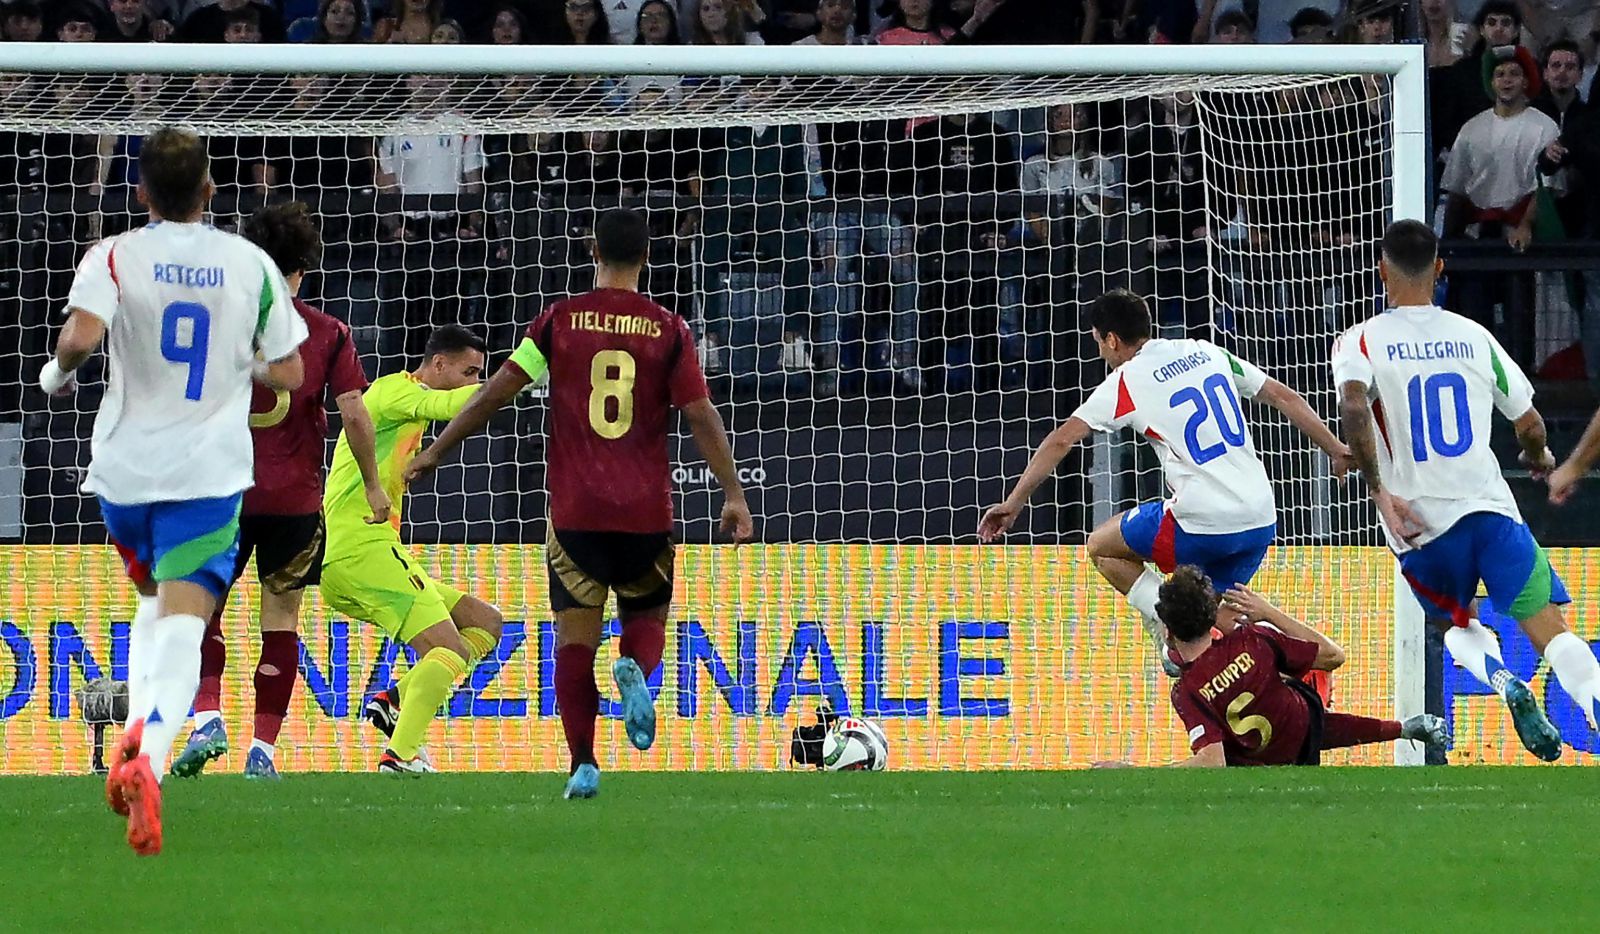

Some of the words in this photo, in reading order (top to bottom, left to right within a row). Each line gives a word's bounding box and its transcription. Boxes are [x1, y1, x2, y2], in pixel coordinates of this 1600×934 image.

[153, 263, 224, 288] RETEGUI
[570, 311, 662, 338] TIELEMANS
[161, 300, 211, 401] 9
[1153, 351, 1211, 383] CAMBIASO
[1387, 341, 1474, 361] PELLEGRINI
[589, 350, 636, 440] 8
[1169, 373, 1245, 465] 20
[1408, 372, 1473, 462] 10
[672, 467, 766, 484] OLIMCO
[1212, 652, 1256, 693] CUYPER
[1226, 691, 1273, 751] 5
